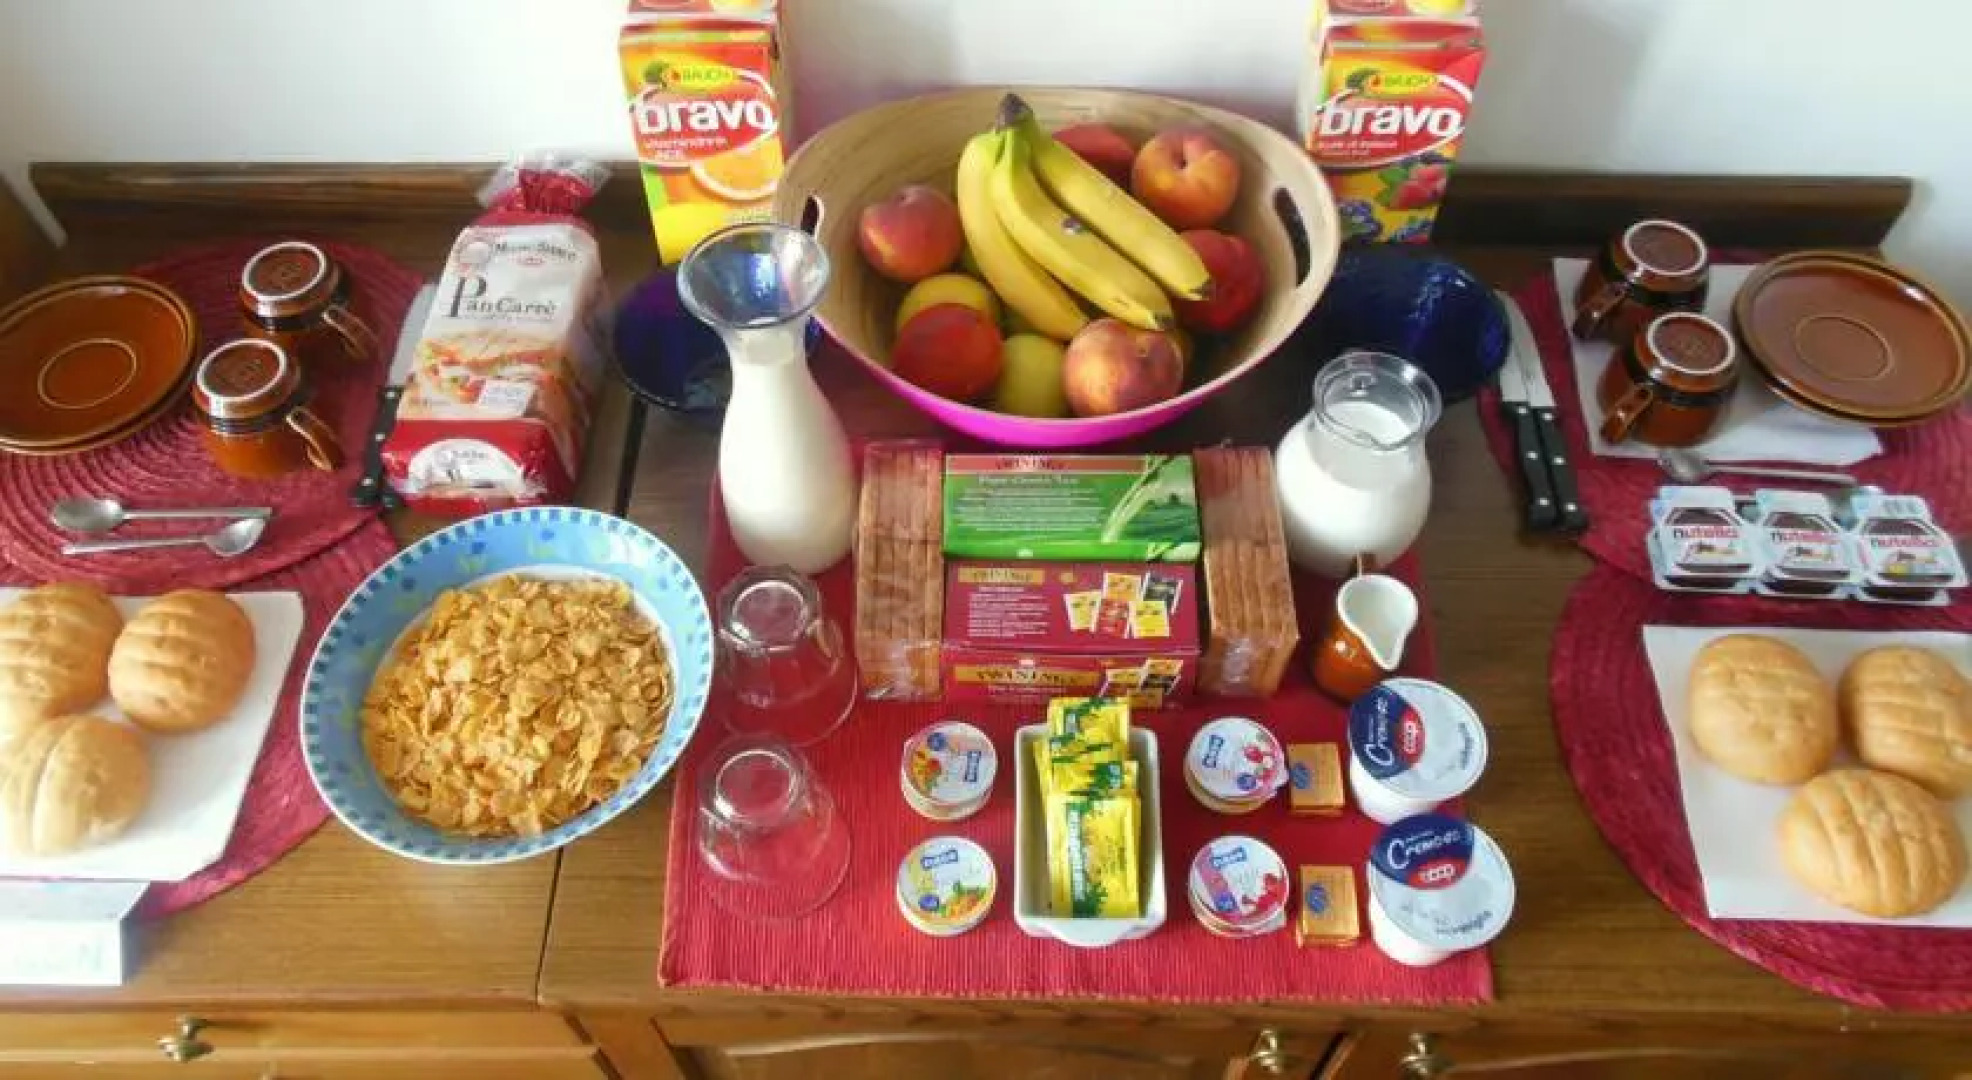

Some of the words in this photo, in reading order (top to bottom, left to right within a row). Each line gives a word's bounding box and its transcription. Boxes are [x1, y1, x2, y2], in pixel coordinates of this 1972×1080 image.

[635, 94, 774, 135] bravo
[1319, 98, 1463, 136] bravo
[1673, 525, 1740, 539] nutella
[1770, 528, 1838, 545] nutella
[1870, 535, 1938, 548] nutella
